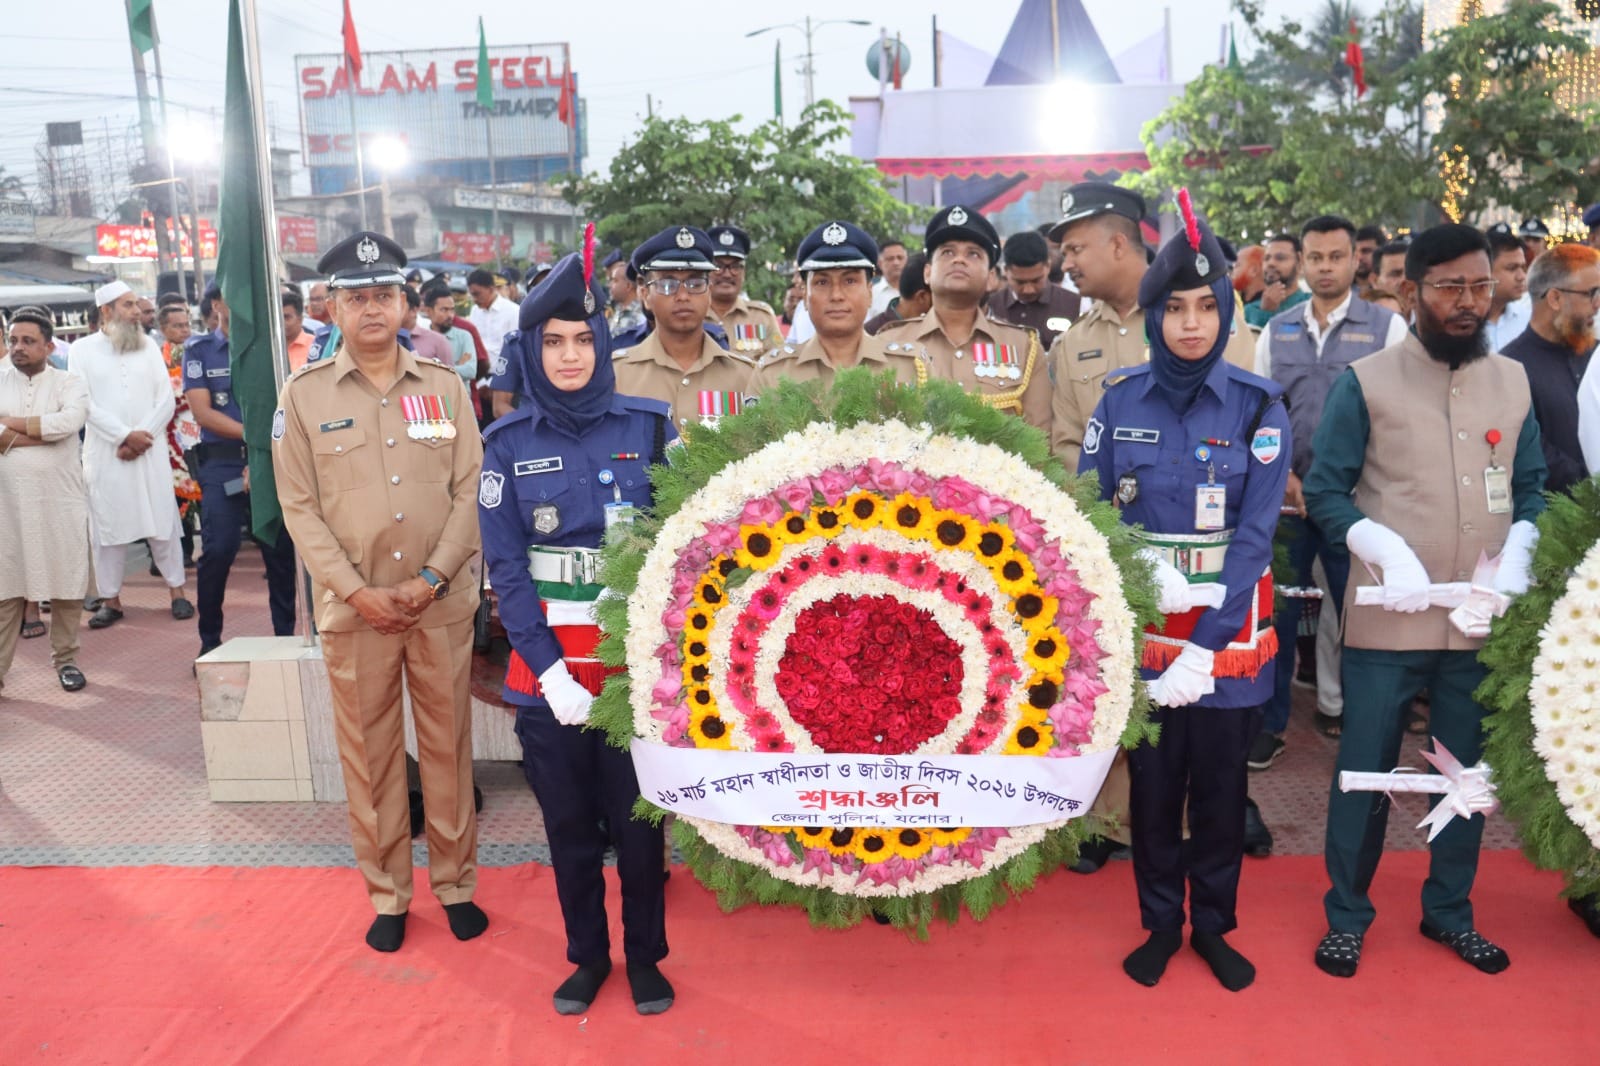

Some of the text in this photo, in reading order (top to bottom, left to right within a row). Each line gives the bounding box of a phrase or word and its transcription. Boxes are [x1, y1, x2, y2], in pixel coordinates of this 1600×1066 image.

[657, 758, 1083, 812] ২৬ মার্চ মহান স্বাধীনতা ও জাতীয় দিবস ২০২৬ উপলক্ষে
[795, 784, 941, 811] শ্রদ্ধাঞ্জলি
[771, 813, 820, 824] জেলা
[828, 812, 886, 825] পুলিশ,
[895, 814, 952, 824] যশোর
